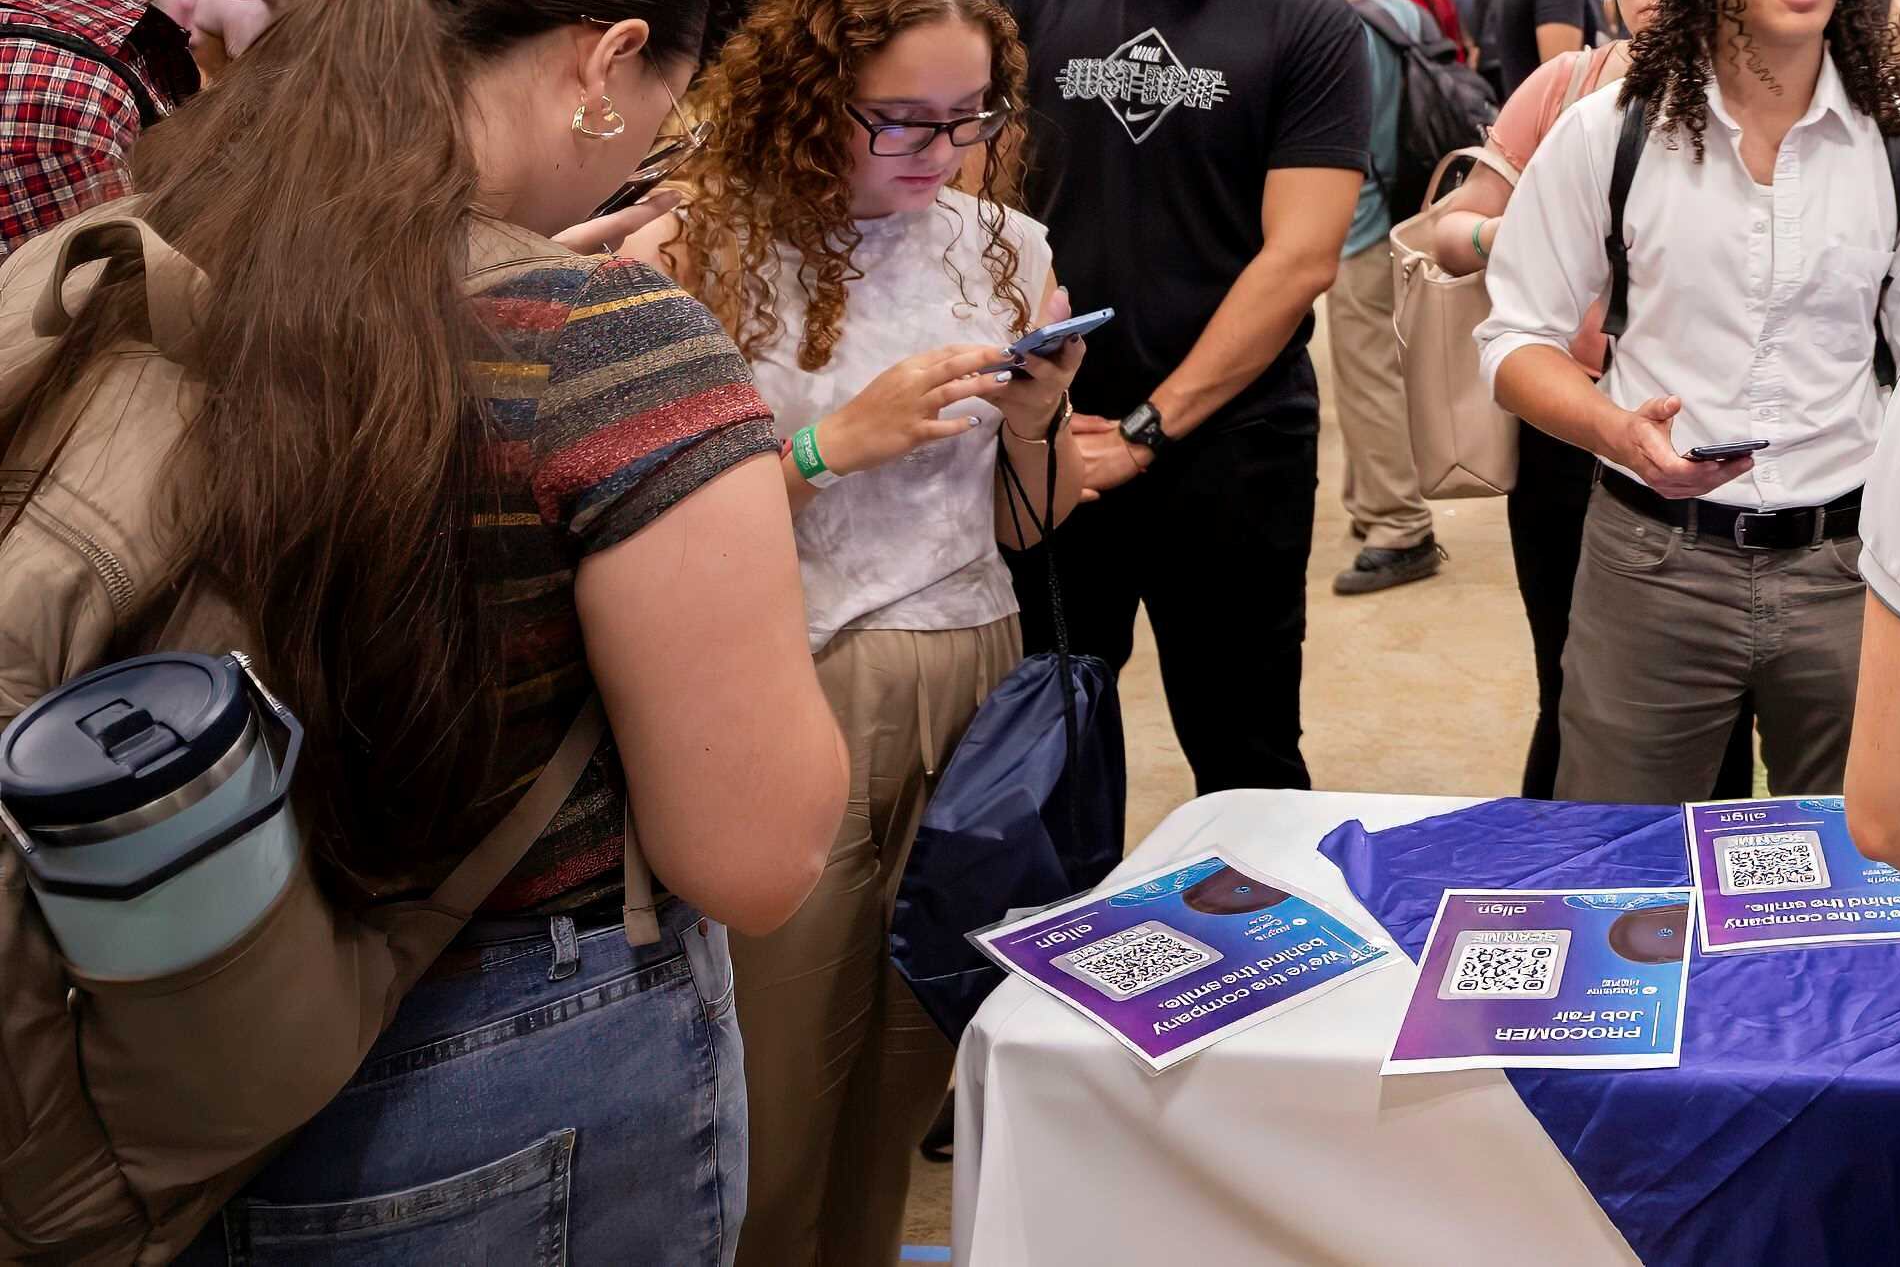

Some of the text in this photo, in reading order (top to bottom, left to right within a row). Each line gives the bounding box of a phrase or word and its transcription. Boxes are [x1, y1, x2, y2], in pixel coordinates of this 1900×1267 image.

[1720, 812, 1767, 823] align
[1478, 903, 1527, 917] align
[1745, 899, 1807, 914] smile.
[1810, 897, 1844, 909] the
[1724, 914, 1822, 929] company
[1826, 911, 1861, 923] the
[1036, 924, 1093, 949] align
[1158, 937, 1328, 1010] behind the smile.
[1153, 949, 1346, 1036] We're the company
[1552, 1010, 1644, 1023] Job Fair
[1495, 1026, 1642, 1041] PROCOMER
